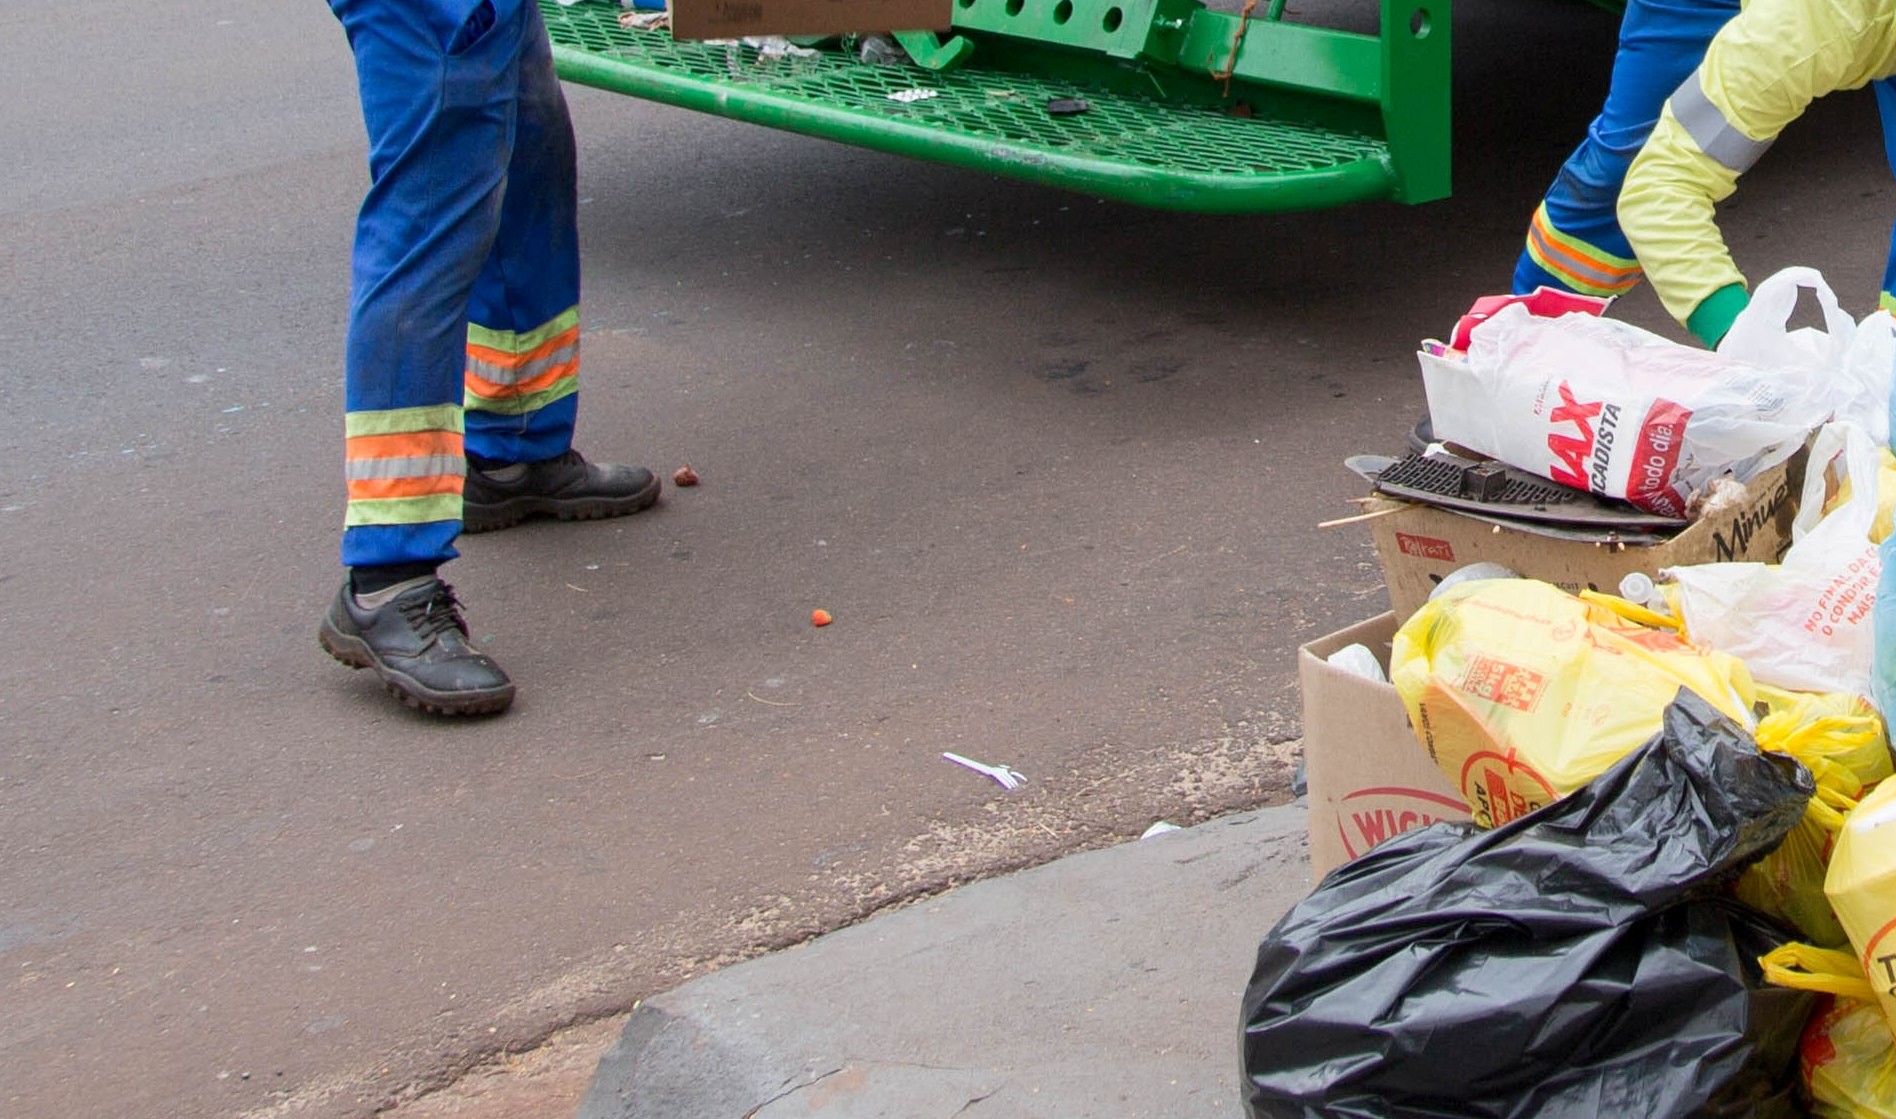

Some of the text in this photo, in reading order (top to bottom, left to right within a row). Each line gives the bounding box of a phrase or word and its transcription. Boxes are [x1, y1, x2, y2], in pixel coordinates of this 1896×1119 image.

[1639, 455, 1666, 492] todo
[1804, 611, 1824, 632] NO
[1818, 575, 1852, 610] FINAL
[1848, 558, 1868, 573] DA
[1821, 624, 1834, 637] O
[1829, 576, 1869, 624] CONDOR
[1847, 593, 1877, 625] MAIS
